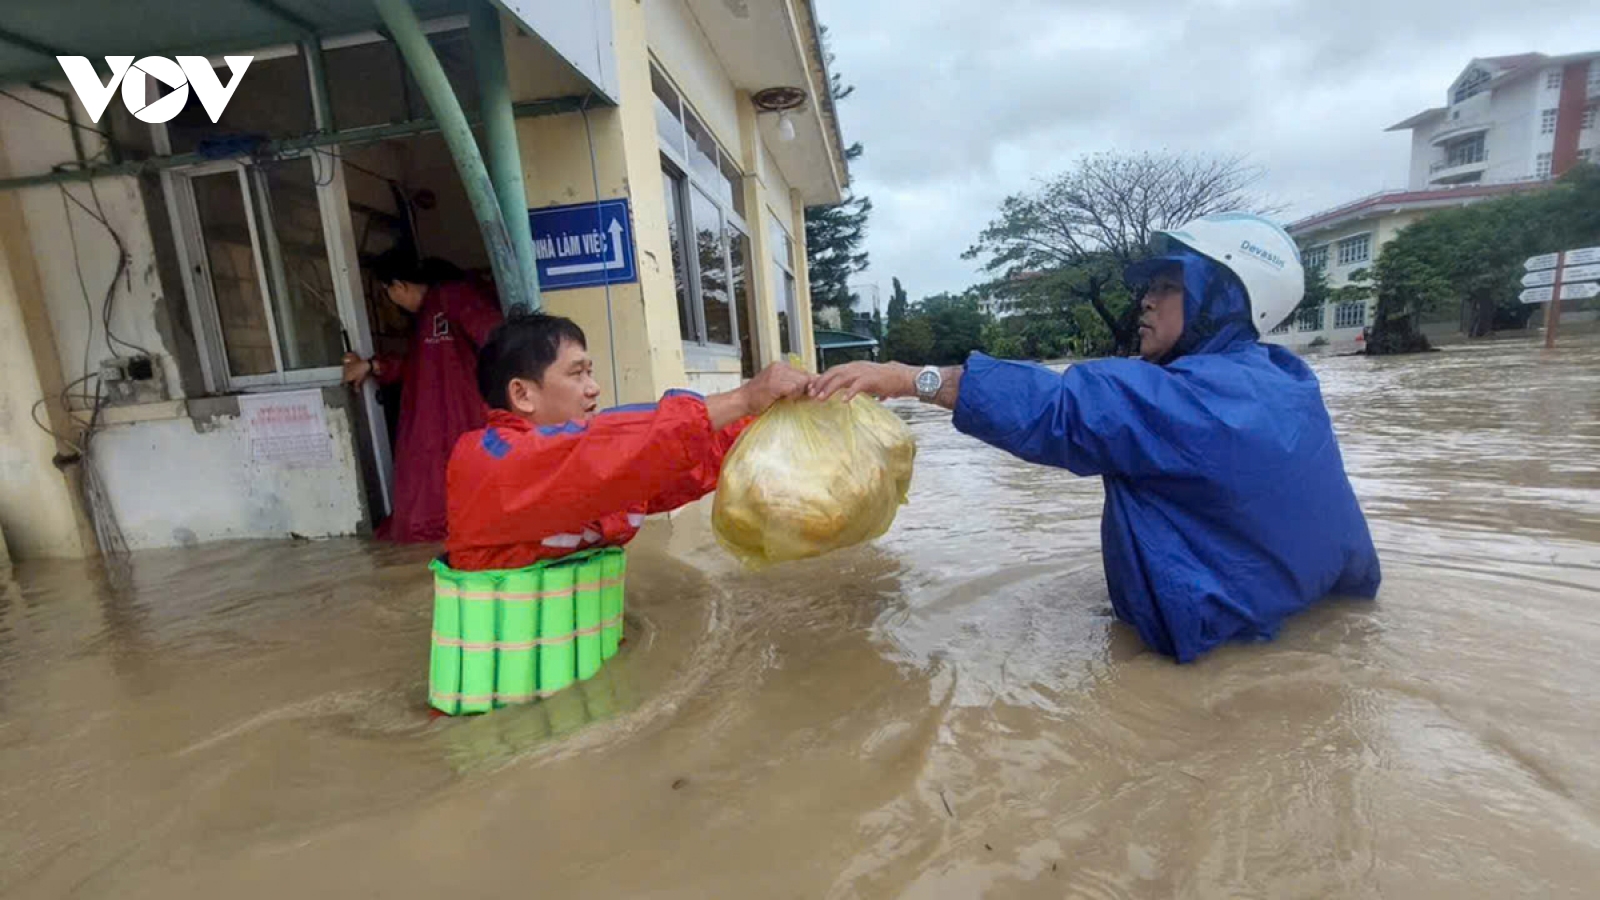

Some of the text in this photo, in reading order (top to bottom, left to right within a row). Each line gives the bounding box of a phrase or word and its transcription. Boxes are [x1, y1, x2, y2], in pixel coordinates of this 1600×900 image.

[533, 228, 608, 259] NHÀ LÀM VIỆC
